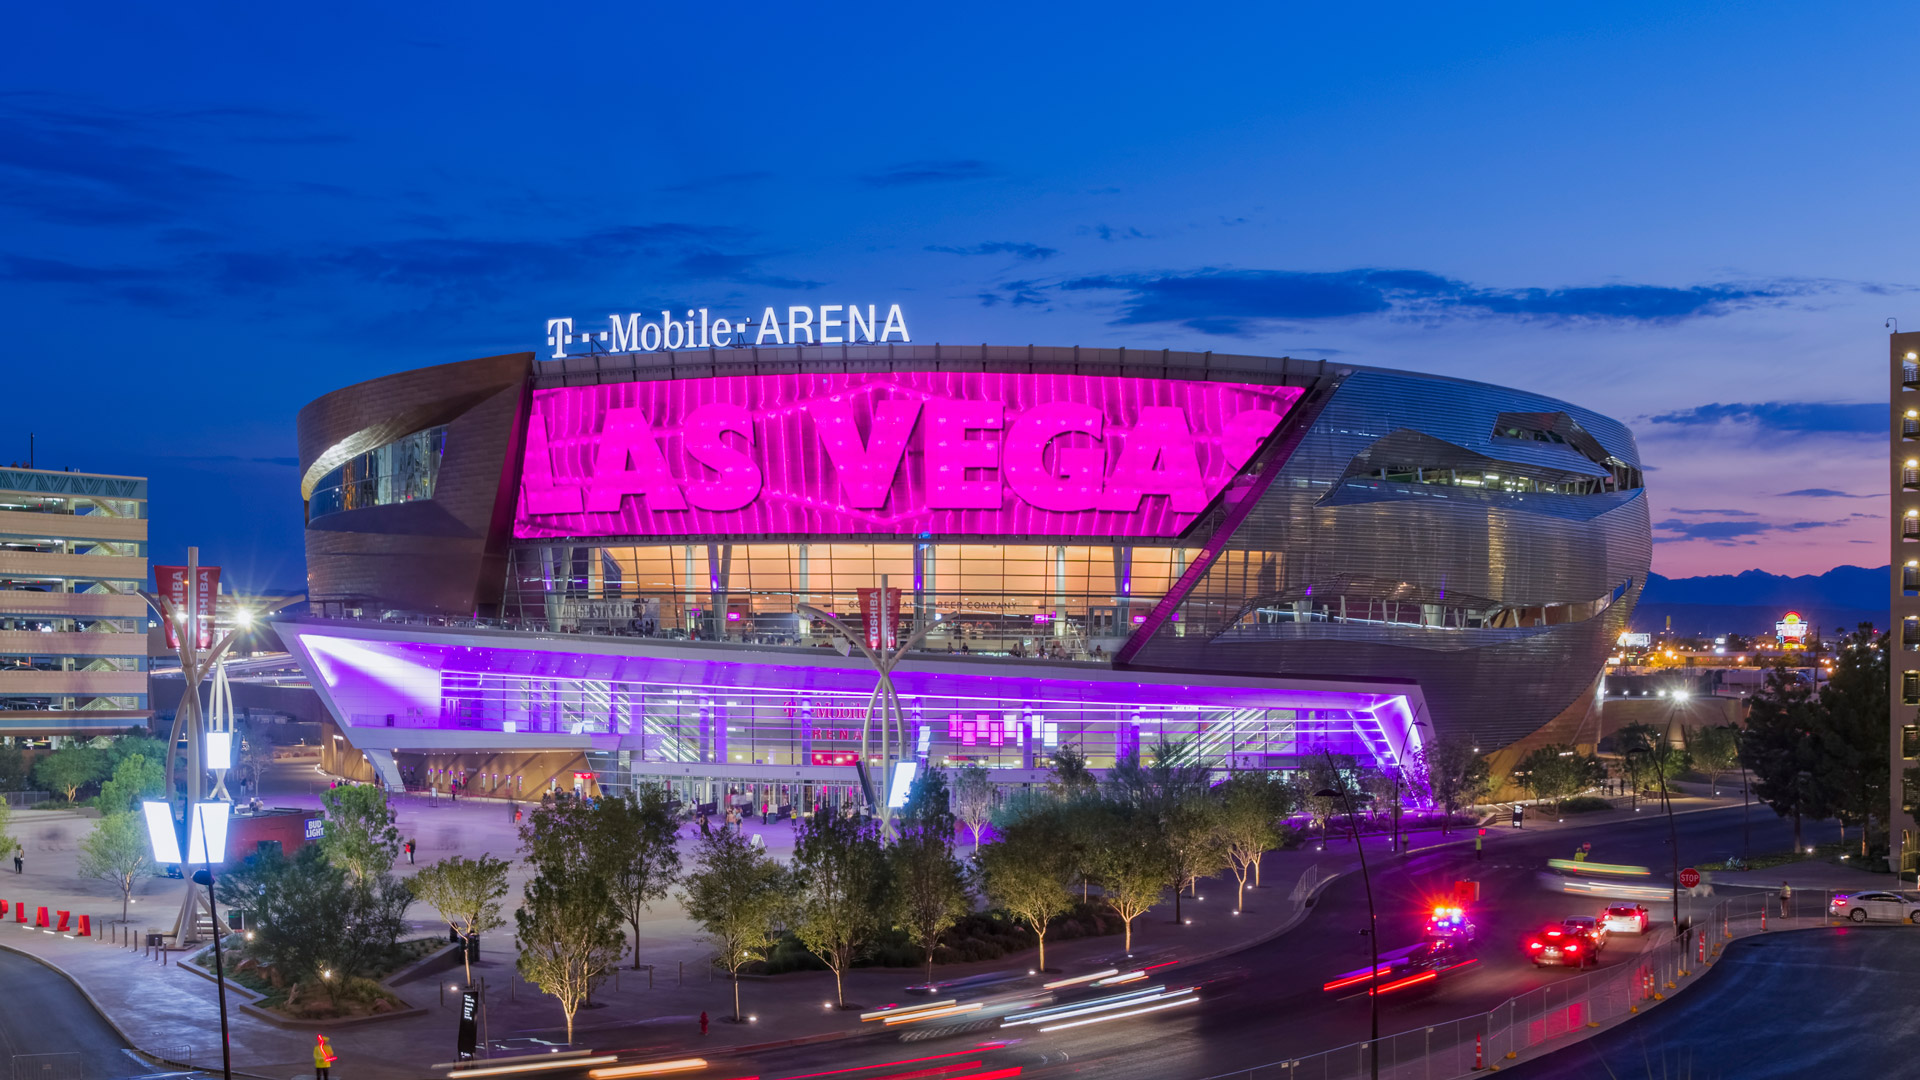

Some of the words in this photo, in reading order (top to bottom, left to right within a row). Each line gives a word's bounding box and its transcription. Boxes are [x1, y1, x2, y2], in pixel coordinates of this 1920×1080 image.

[756, 304, 911, 345] ARENA
[523, 402, 764, 515] LAS
[199, 571, 209, 640] TOSHIBA
[593, 601, 635, 618] STRAIT
[966, 601, 1018, 609] COMPANY
[869, 591, 878, 642] TOSHIBA
[799, 727, 863, 740] RENA
[308, 820, 322, 829] BUD
[306, 827, 324, 838] LIGHT
[1680, 874, 1699, 882] STOP
